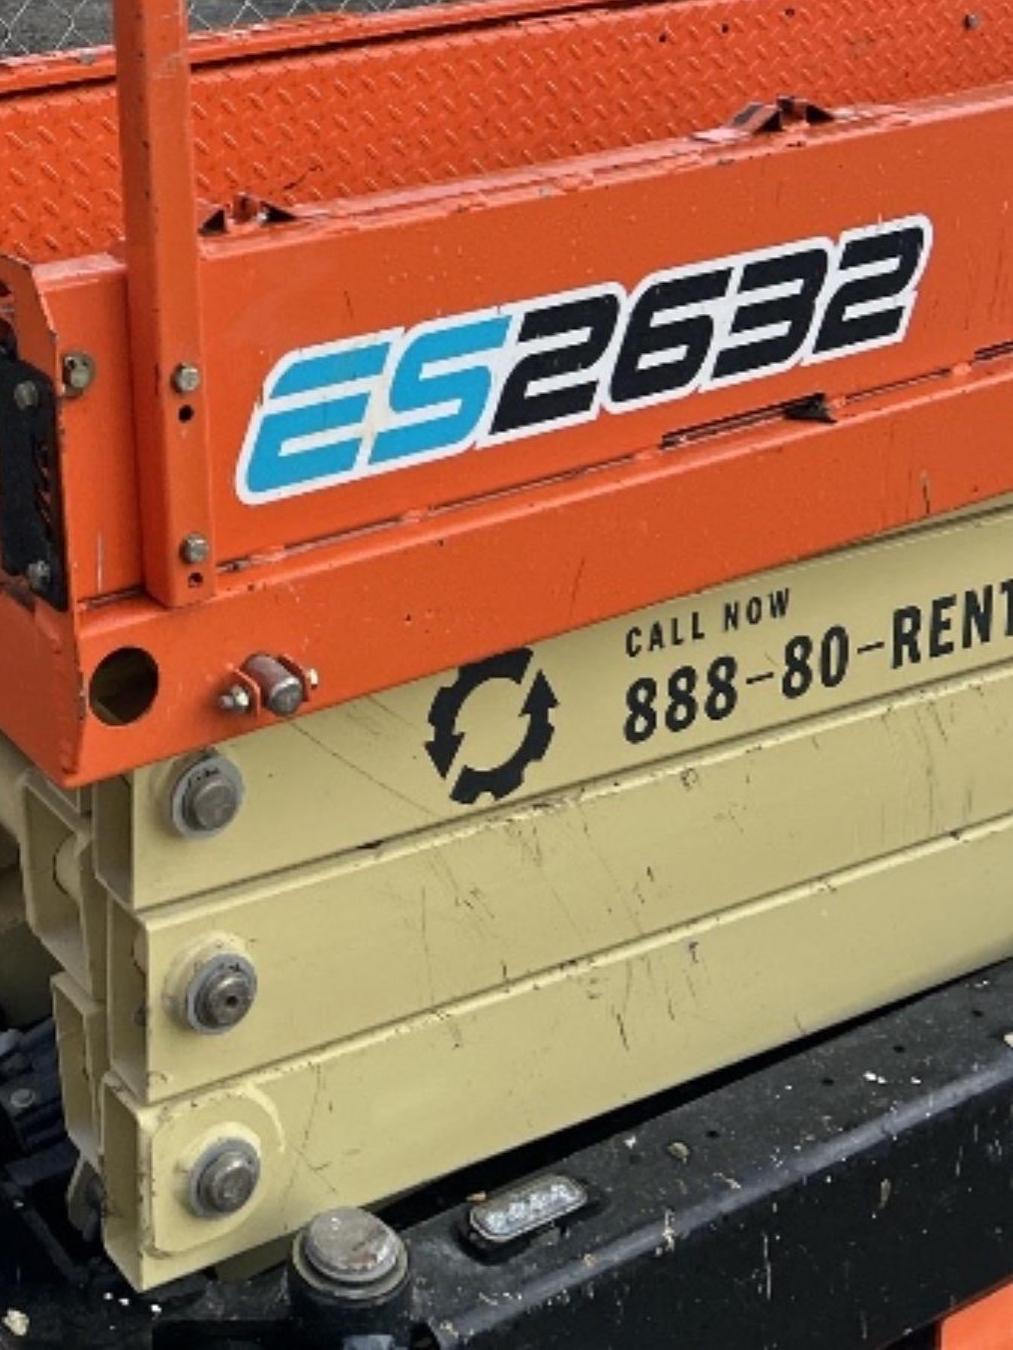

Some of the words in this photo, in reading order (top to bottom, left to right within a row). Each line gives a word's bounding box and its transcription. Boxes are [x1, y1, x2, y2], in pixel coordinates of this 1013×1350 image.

[242, 222, 928, 496] ES2632
[625, 612, 705, 657] CALL
[723, 588, 790, 632] NOW
